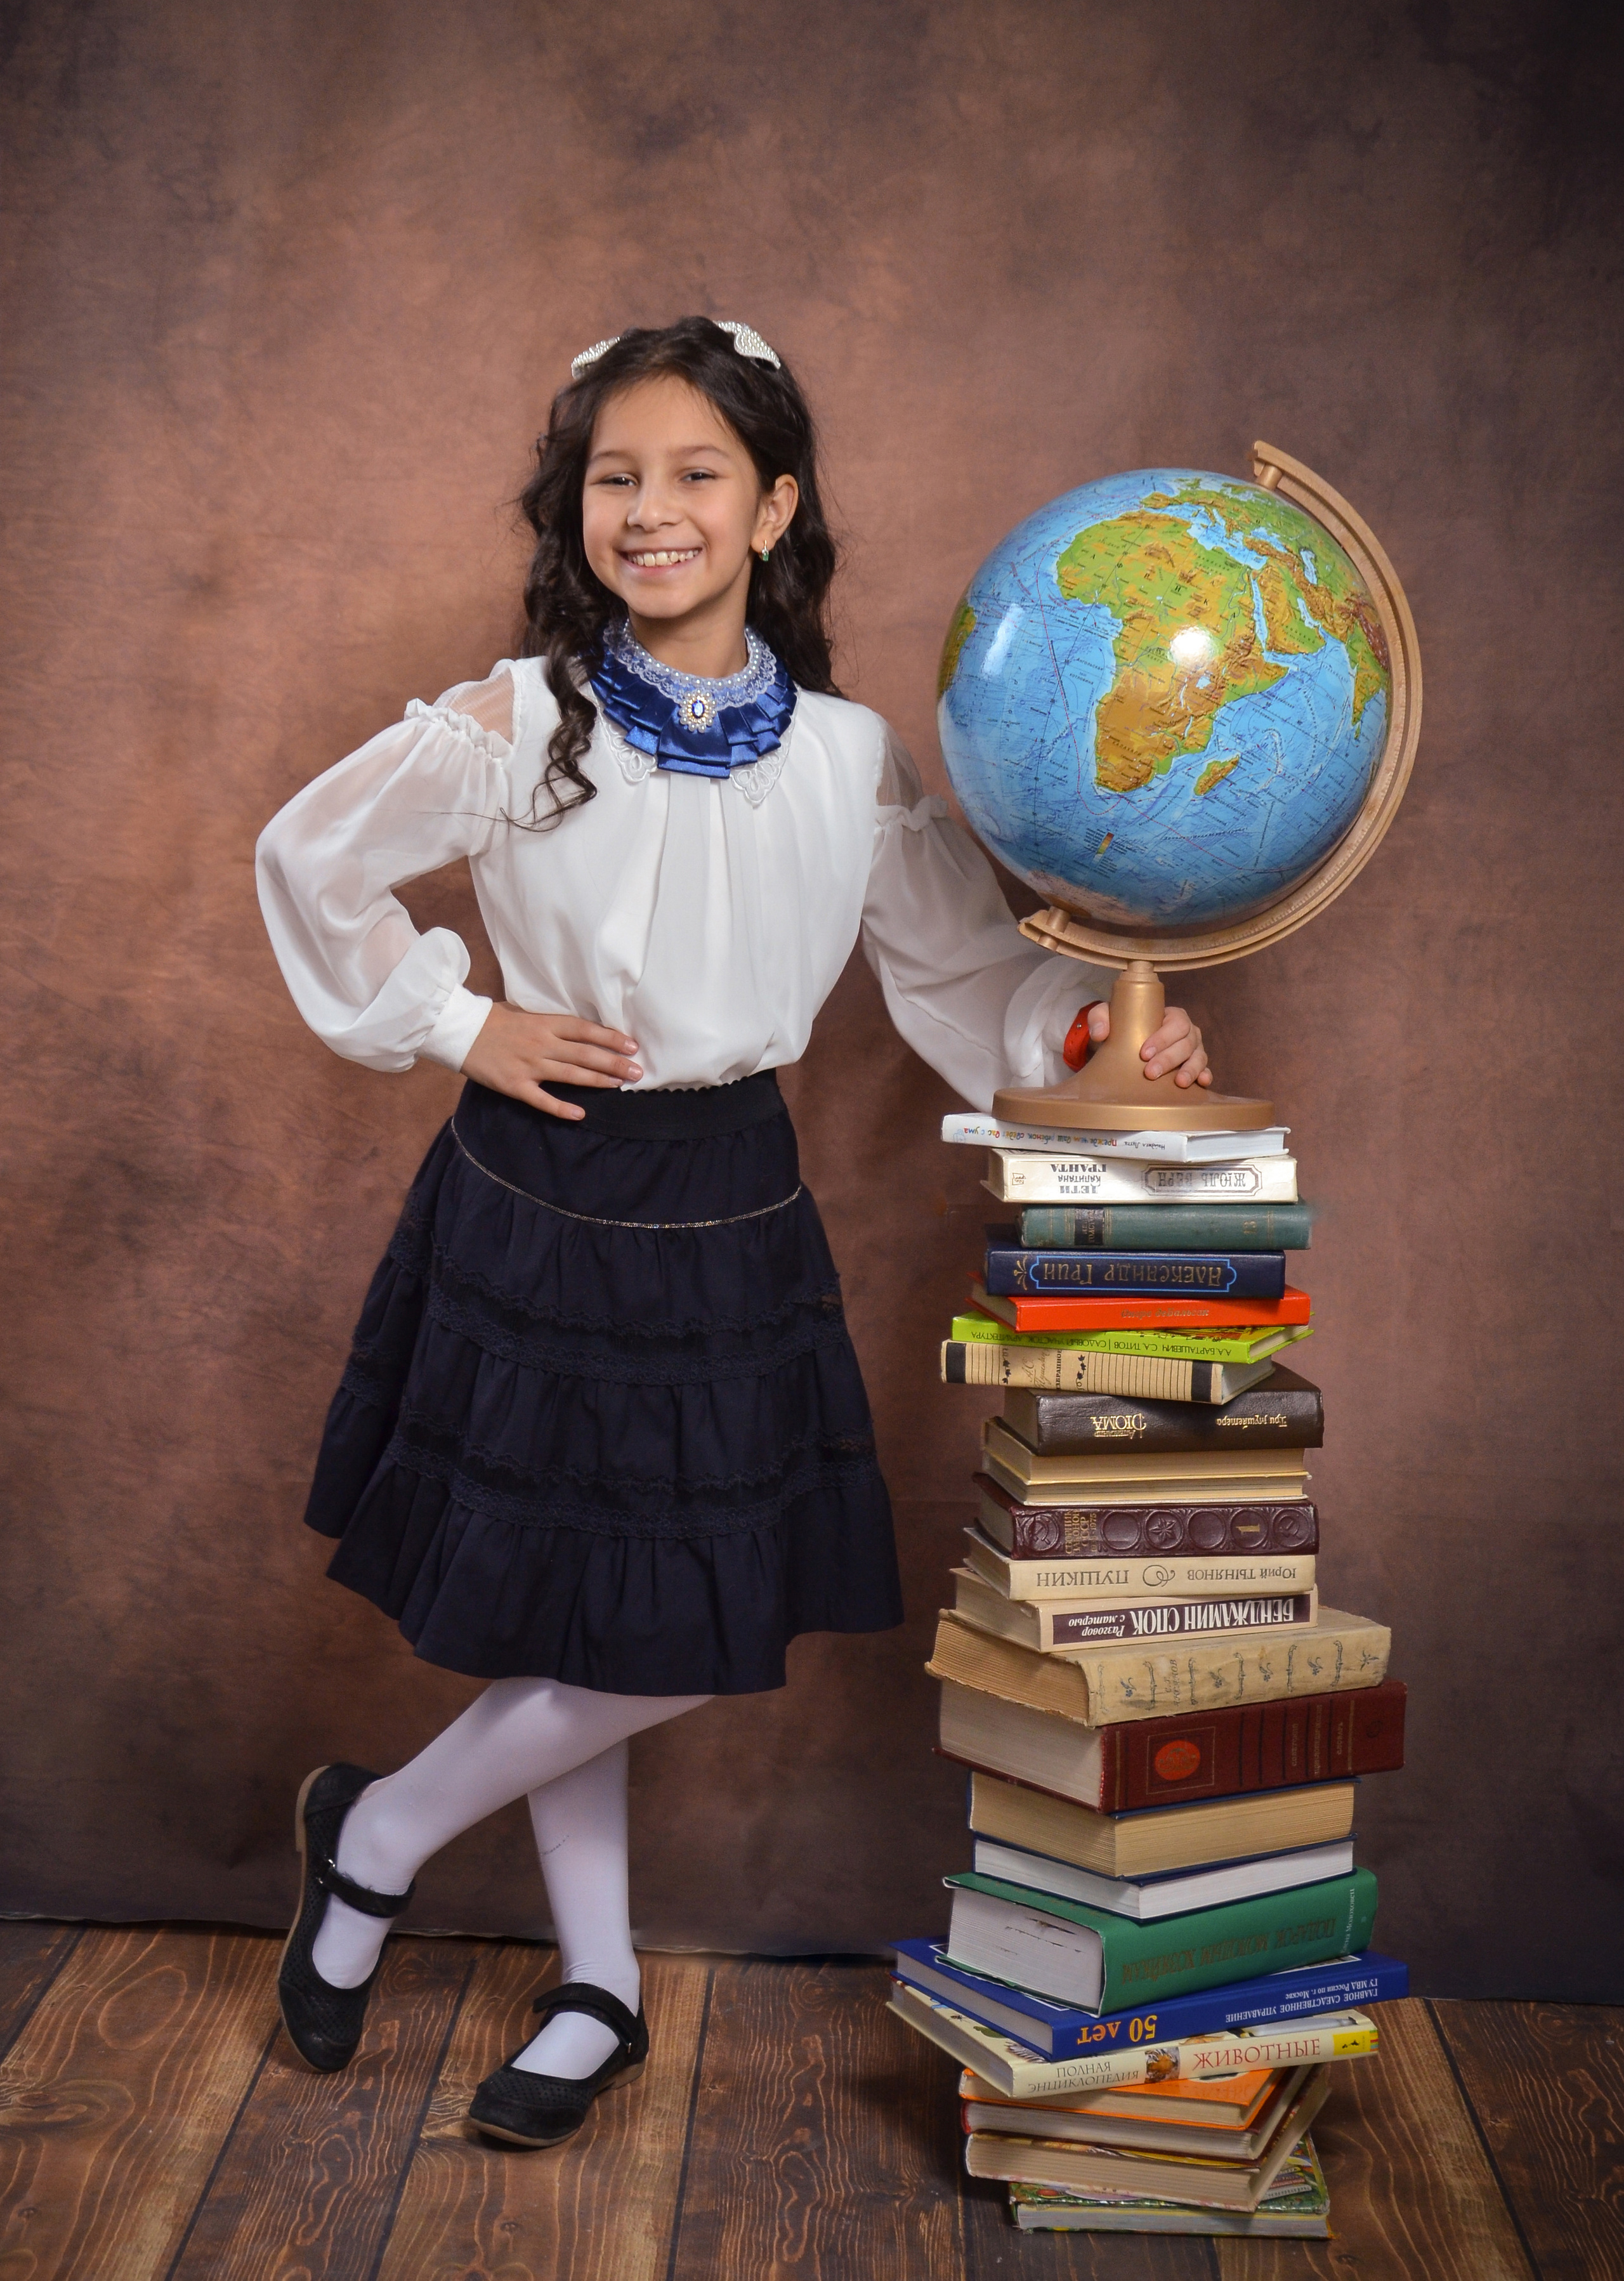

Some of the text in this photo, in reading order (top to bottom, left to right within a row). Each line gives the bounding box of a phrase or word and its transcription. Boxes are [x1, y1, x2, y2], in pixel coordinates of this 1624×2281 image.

[964, 1126, 980, 1135] ума
[988, 1130, 1000, 1139] вас
[1058, 1135, 1071, 1144] ваш
[1090, 1138, 1117, 1147] Прежде
[1124, 1140, 1141, 1149] Латта
[1051, 1163, 1106, 1173] ГРАНТА
[1058, 1175, 1101, 1186] КАПИТАНА
[1158, 1172, 1246, 1187] ЖЮЛЬ ВЕРН
[1060, 1185, 1098, 1194] ДЕТИ
[1044, 1262, 1222, 1286] АЛЕКСАНДР ГРИН
[971, 1331, 1023, 1342] АРХИТЕКТУРА
[1064, 1337, 1107, 1348] САДОВЫЙ
[1114, 1341, 1141, 1350] ТИТОВ
[1162, 1345, 1215, 1356] БАРТАШЕВИЧ
[1090, 1413, 1147, 1432] ДЮМА
[1269, 1415, 1287, 1428] Три
[1080, 1517, 1089, 1547] СССР
[1037, 1566, 1296, 1587] Юрий ТЫНЯНОВ ПУШКИН
[1068, 1616, 1118, 1627] матерью
[1130, 1598, 1295, 1635] БЕНДЖАМИН СПОК
[1082, 1625, 1125, 1637] Разговор
[1345, 1888, 1356, 1933] Молоховец
[1122, 1918, 1337, 1985] ПОДАРОК МОЛОДЫМ ХОЗЯЙКАМ
[1351, 1980, 1368, 1990] МВД
[1369, 1978, 1378, 1987] ГУ
[1327, 1984, 1349, 1993] России
[1285, 1990, 1310, 1999] Москве
[1226, 1989, 1378, 2023] ГЛАВНОЕ СЛЕДСТВЕННОЕ УПРАВЛЕНИЕ
[1077, 2015, 1158, 2046] 50 лет
[1193, 2038, 1321, 2071] ЖИВОТНЫЕ
[1057, 2062, 1111, 2078] ПОЛНАЯ
[1028, 2070, 1139, 2093] ЭНЦИКЛОПЕДИЯ
